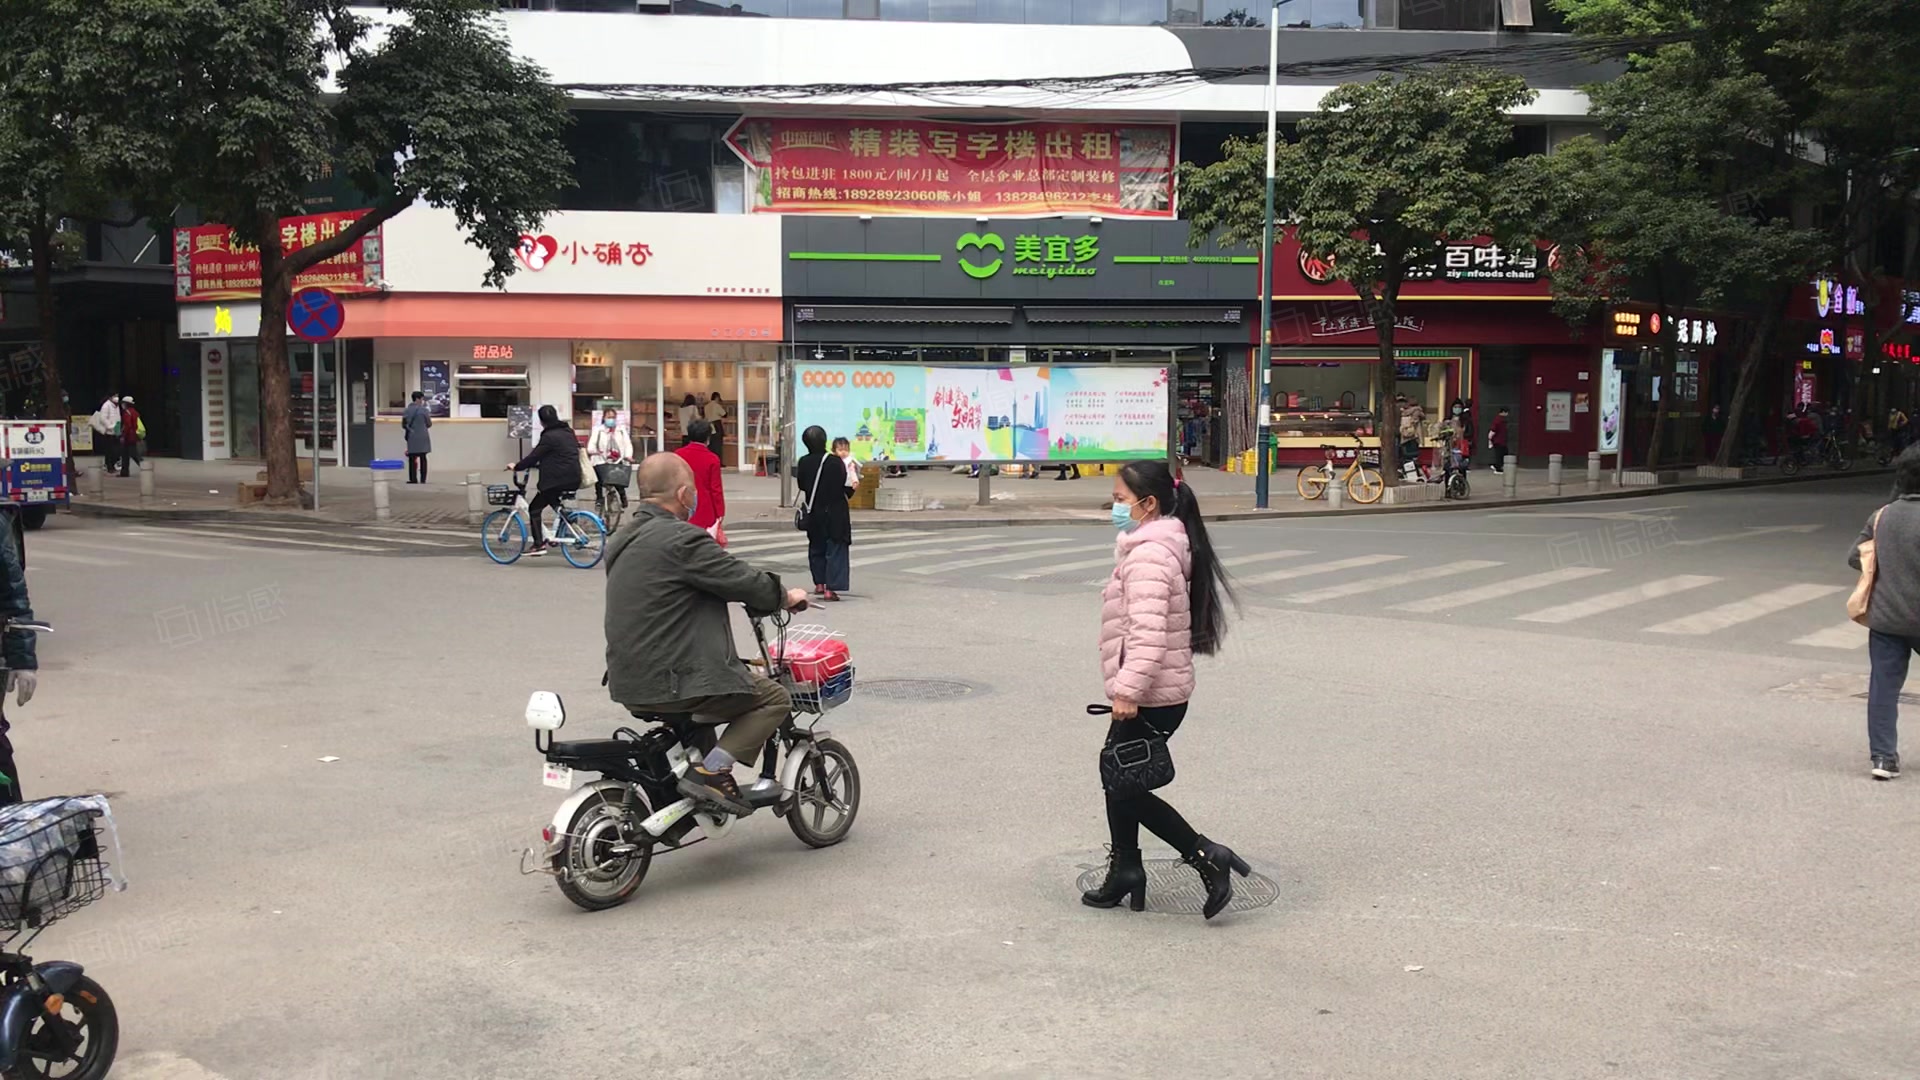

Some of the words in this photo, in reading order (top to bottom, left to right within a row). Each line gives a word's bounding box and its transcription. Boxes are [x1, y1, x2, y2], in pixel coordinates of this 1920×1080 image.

[849, 127, 1114, 160] 精装写字楼出租
[774, 167, 836, 182] 拎包进驻
[967, 168, 1115, 184] 全层企业总部定制装修
[1014, 234, 1099, 263] 美宜多
[1013, 264, 1097, 280] meiyiduo
[1505, 270, 1535, 279] chain
[473, 344, 513, 359] 甜品站
